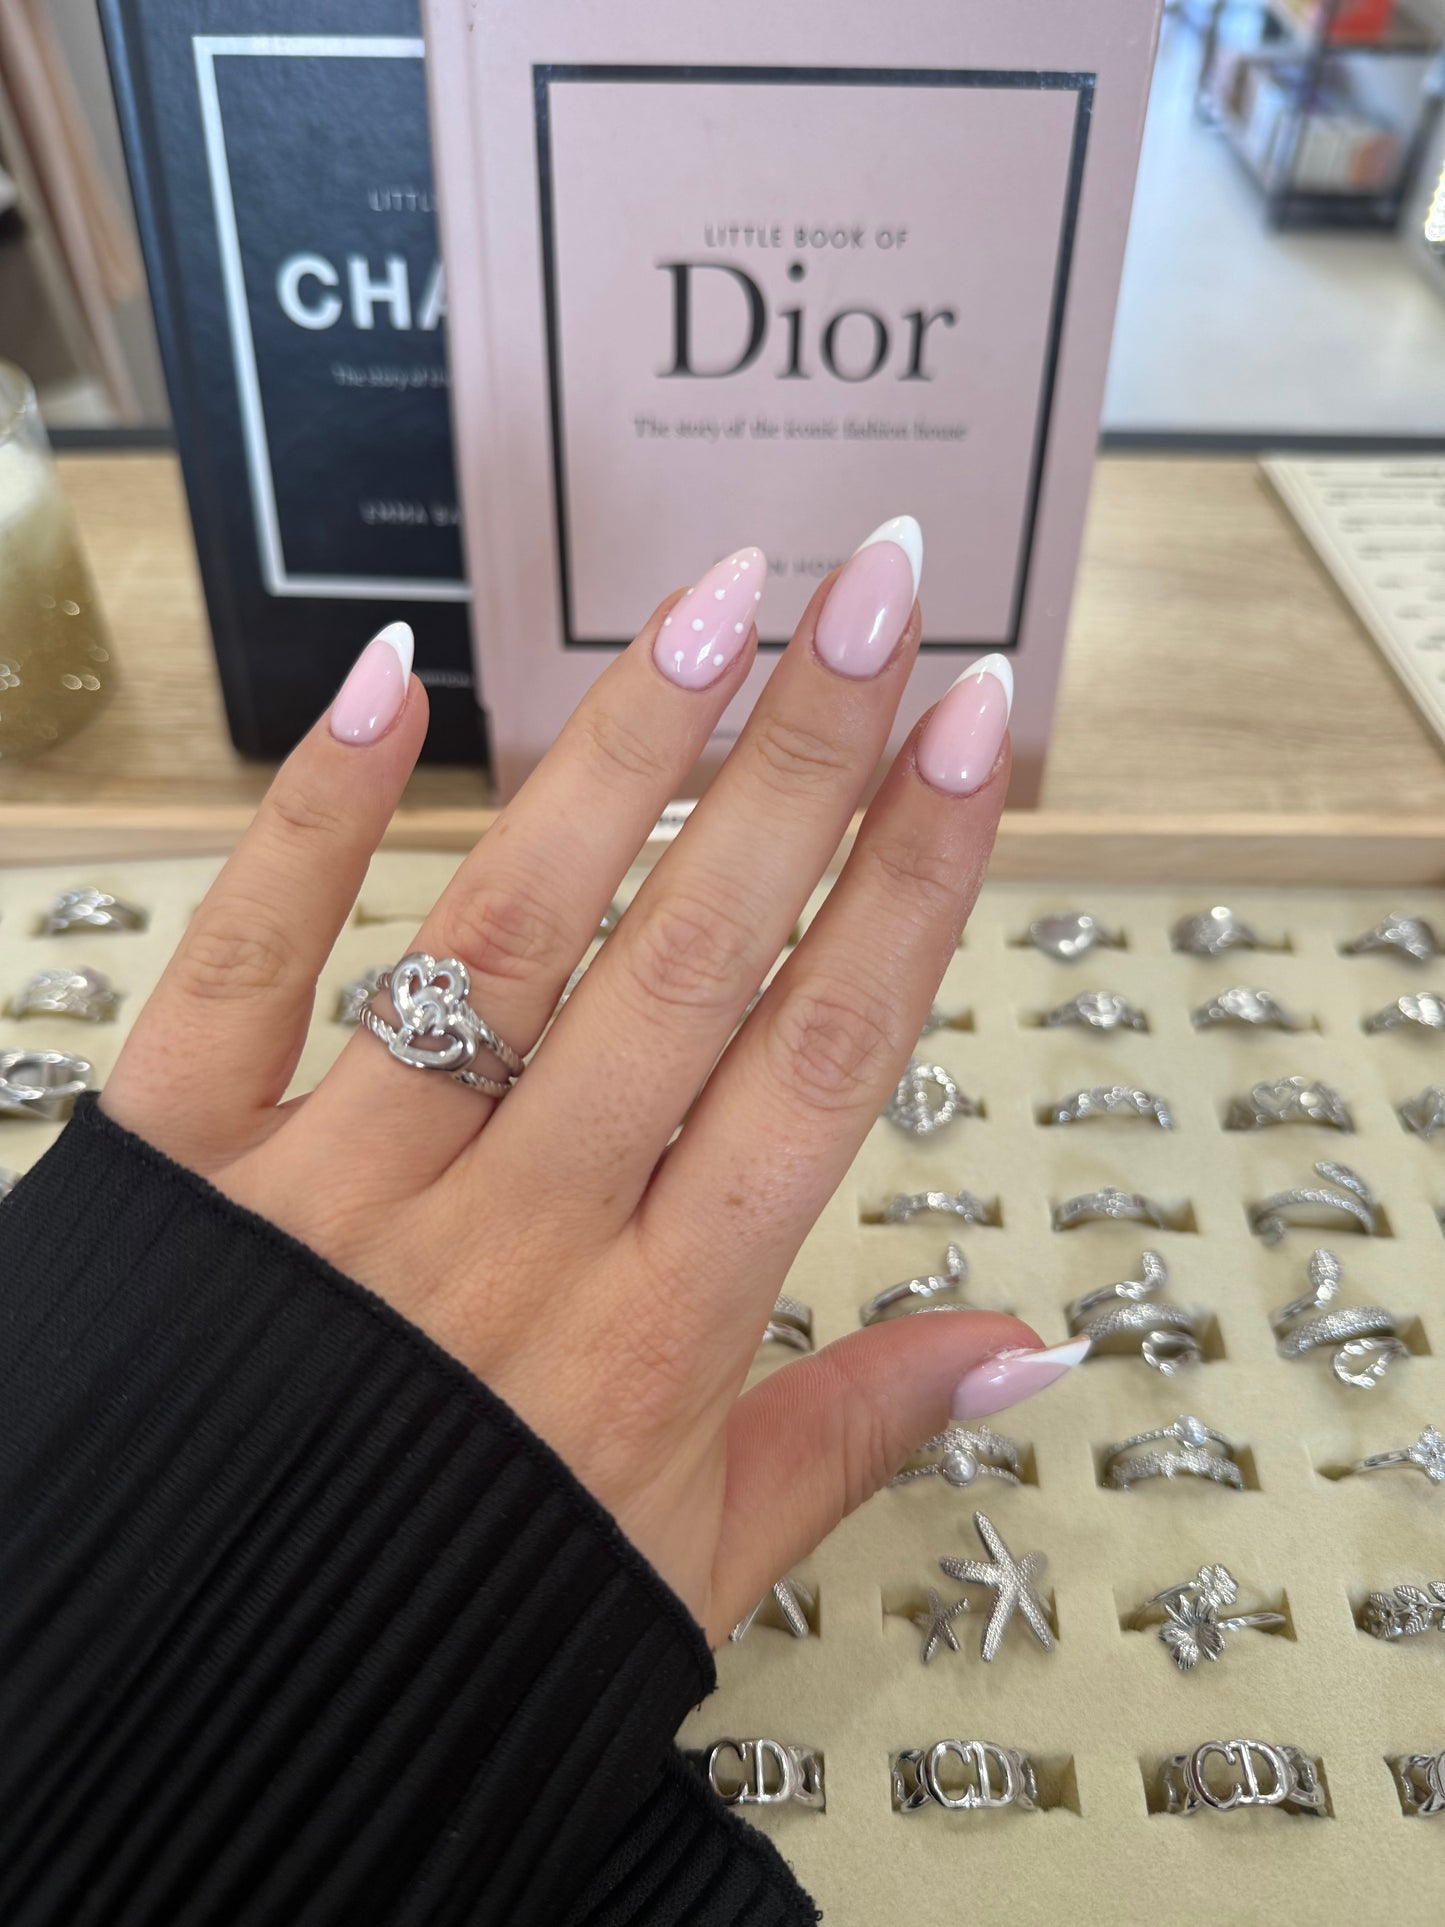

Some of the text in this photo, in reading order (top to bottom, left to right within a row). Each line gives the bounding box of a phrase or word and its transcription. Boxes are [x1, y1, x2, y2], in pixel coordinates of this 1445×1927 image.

[704, 223, 909, 250] LITTLE BOOK OF
[654, 260, 960, 383] Dior
[634, 416, 670, 439] The
[675, 416, 722, 444] story
[723, 415, 747, 440] of
[751, 415, 779, 440] the
